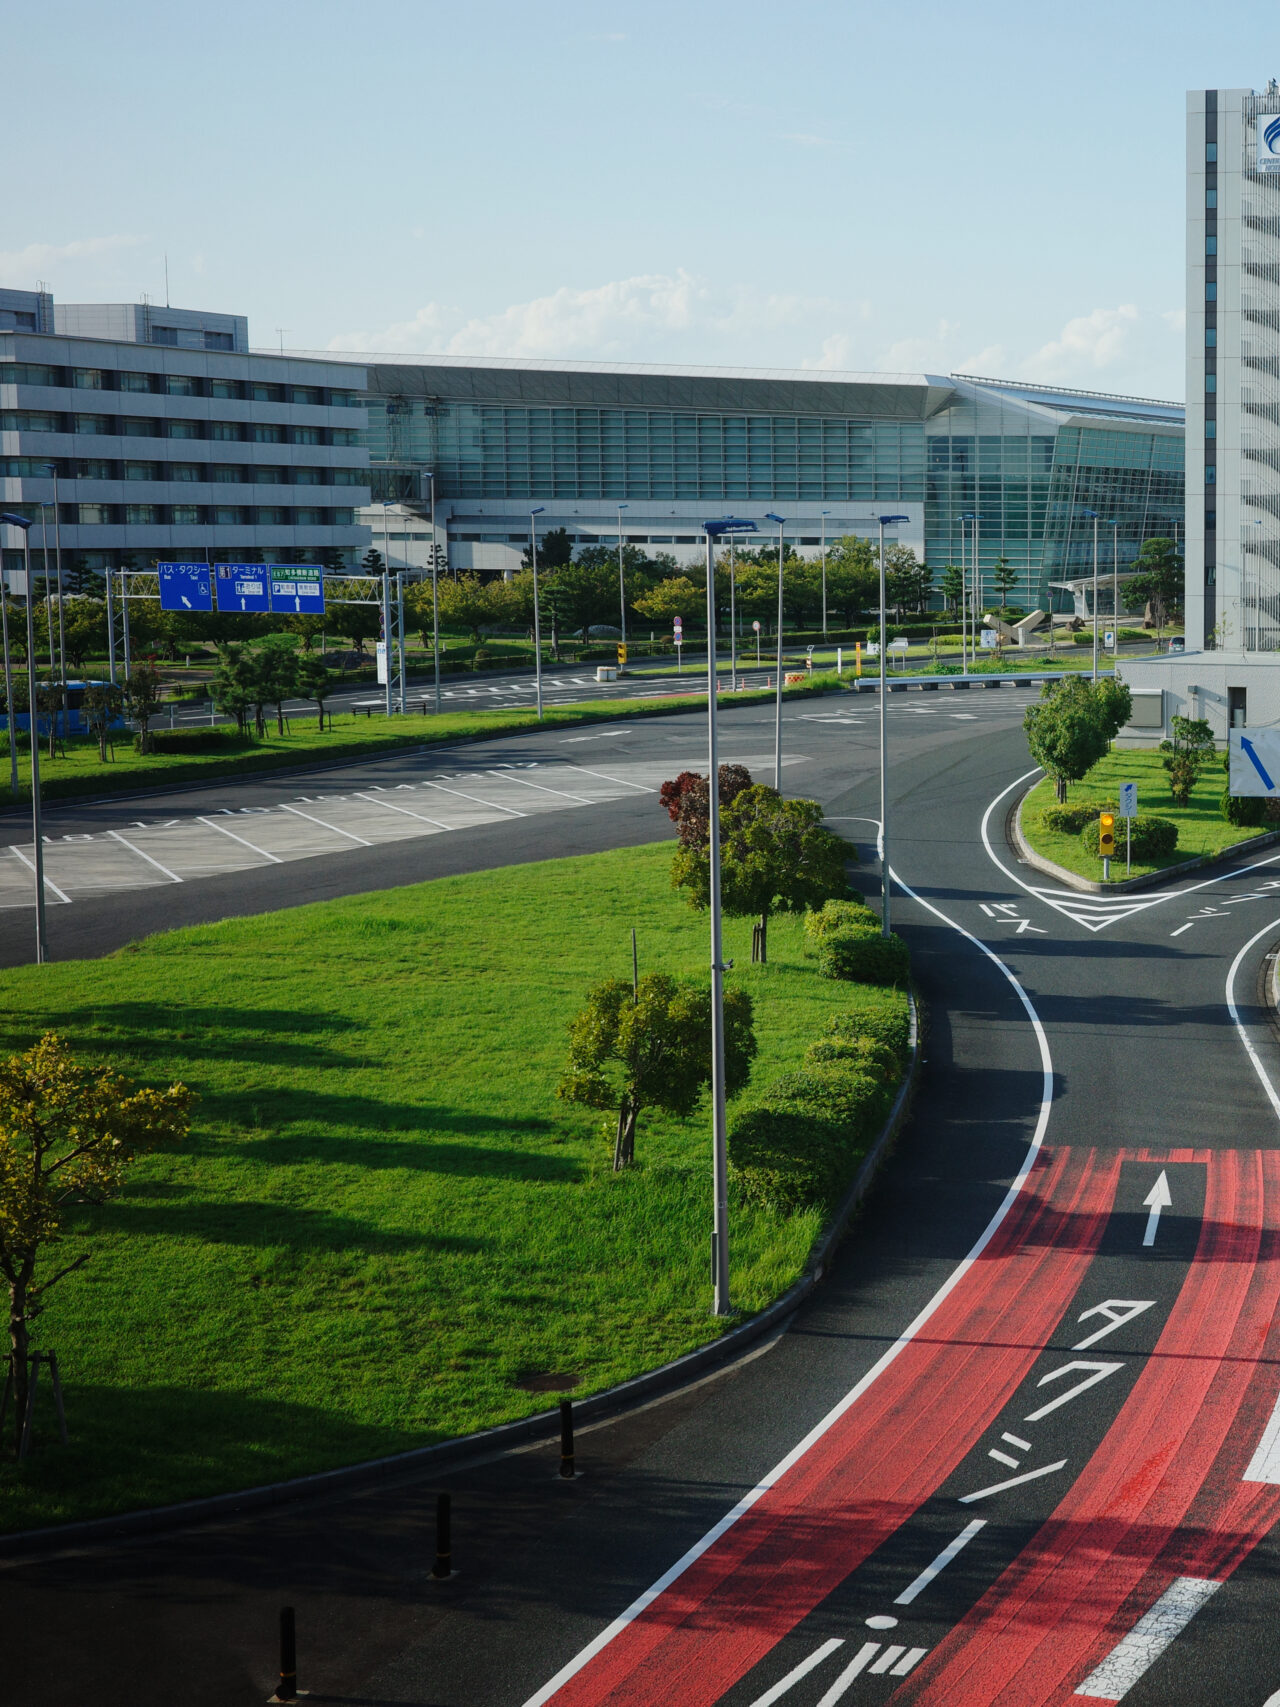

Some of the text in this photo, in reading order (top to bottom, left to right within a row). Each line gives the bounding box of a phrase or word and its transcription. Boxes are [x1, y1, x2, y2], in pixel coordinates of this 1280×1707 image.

[232, 566, 264, 575] ターミナル
[978, 903, 1049, 933] バス
